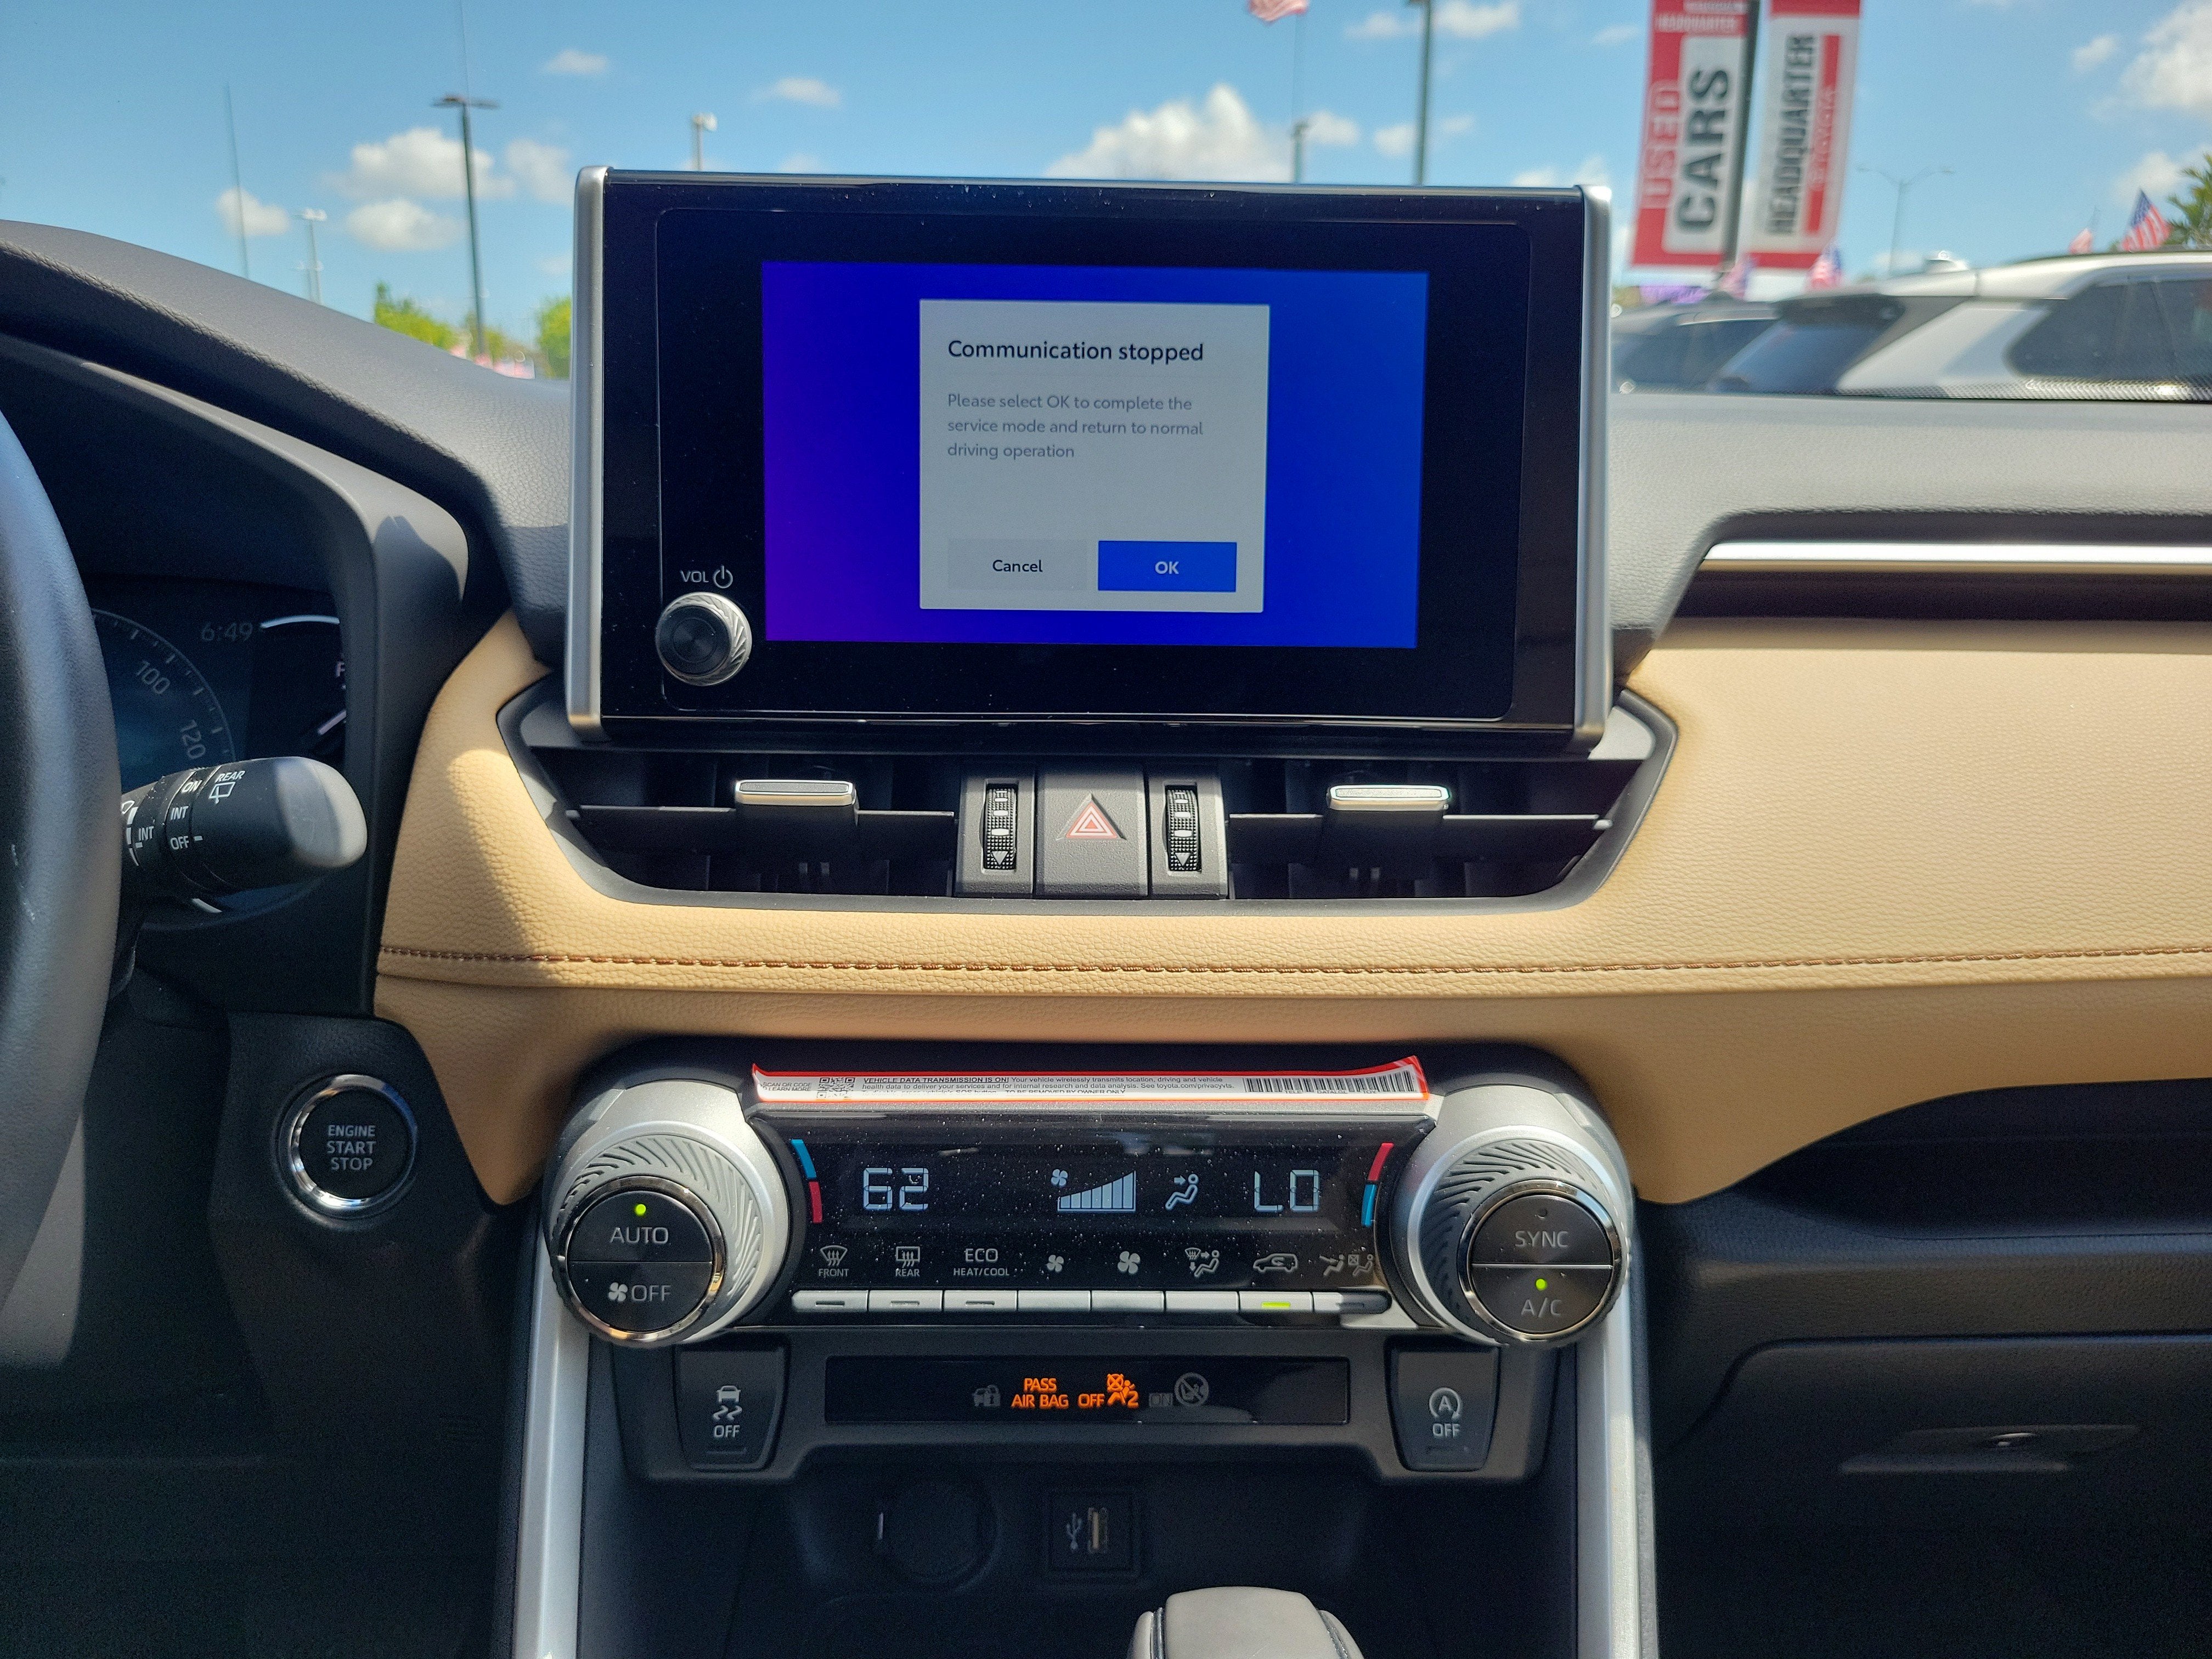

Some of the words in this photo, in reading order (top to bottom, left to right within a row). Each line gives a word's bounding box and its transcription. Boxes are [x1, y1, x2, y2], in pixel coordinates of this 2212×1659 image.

[1644, 81, 1680, 205] USED
[1676, 69, 1730, 233] CARS
[948, 340, 1112, 359] Communication
[1118, 343, 1204, 365] stopped
[948, 393, 996, 408] Please
[1000, 394, 1043, 408] select
[1047, 395, 1070, 408] OK
[1074, 397, 1090, 409] to
[1093, 397, 1164, 412] complete
[1168, 397, 1192, 410] the
[947, 419, 998, 432] service
[1002, 419, 1046, 433] mode
[1049, 420, 1077, 433] and
[1082, 421, 1126, 434] return
[1131, 422, 1146, 435] to
[1150, 422, 1203, 436] normal
[947, 443, 998, 460] driving
[1003, 444, 1074, 460] operation
[992, 560, 1043, 572] Cancel
[1154, 561, 1180, 574] OK
[679, 570, 709, 583] VOL
[201, 622, 253, 642] 6:49
[135, 661, 171, 695] 100
[180, 719, 207, 760] 120
[215, 770, 246, 782] REAR
[180, 780, 202, 794] ON
[170, 805, 189, 820] INT
[138, 826, 154, 841] INT
[170, 836, 190, 850] OFF
[328, 1125, 376, 1137] ENGINE
[326, 1141, 377, 1154] START
[330, 1156, 373, 1171] STOP
[862, 1167, 929, 1211] 62
[610, 1226, 669, 1244] AUTO
[1514, 1231, 1569, 1248] SYNC
[964, 1248, 998, 1262] ECO
[818, 1268, 849, 1277] FRONT
[895, 1268, 920, 1277] REAR
[953, 1267, 1010, 1277] HEAT/COOL
[631, 1285, 671, 1302] OFF
[1520, 1298, 1562, 1317] A/C
[1024, 1378, 1057, 1393] PASS
[1011, 1393, 1035, 1408] AIR
[1039, 1393, 1069, 1409] BAG
[1077, 1393, 1105, 1409] OFF
[714, 1425, 741, 1438] OFF
[1432, 1423, 1460, 1438] OFF
